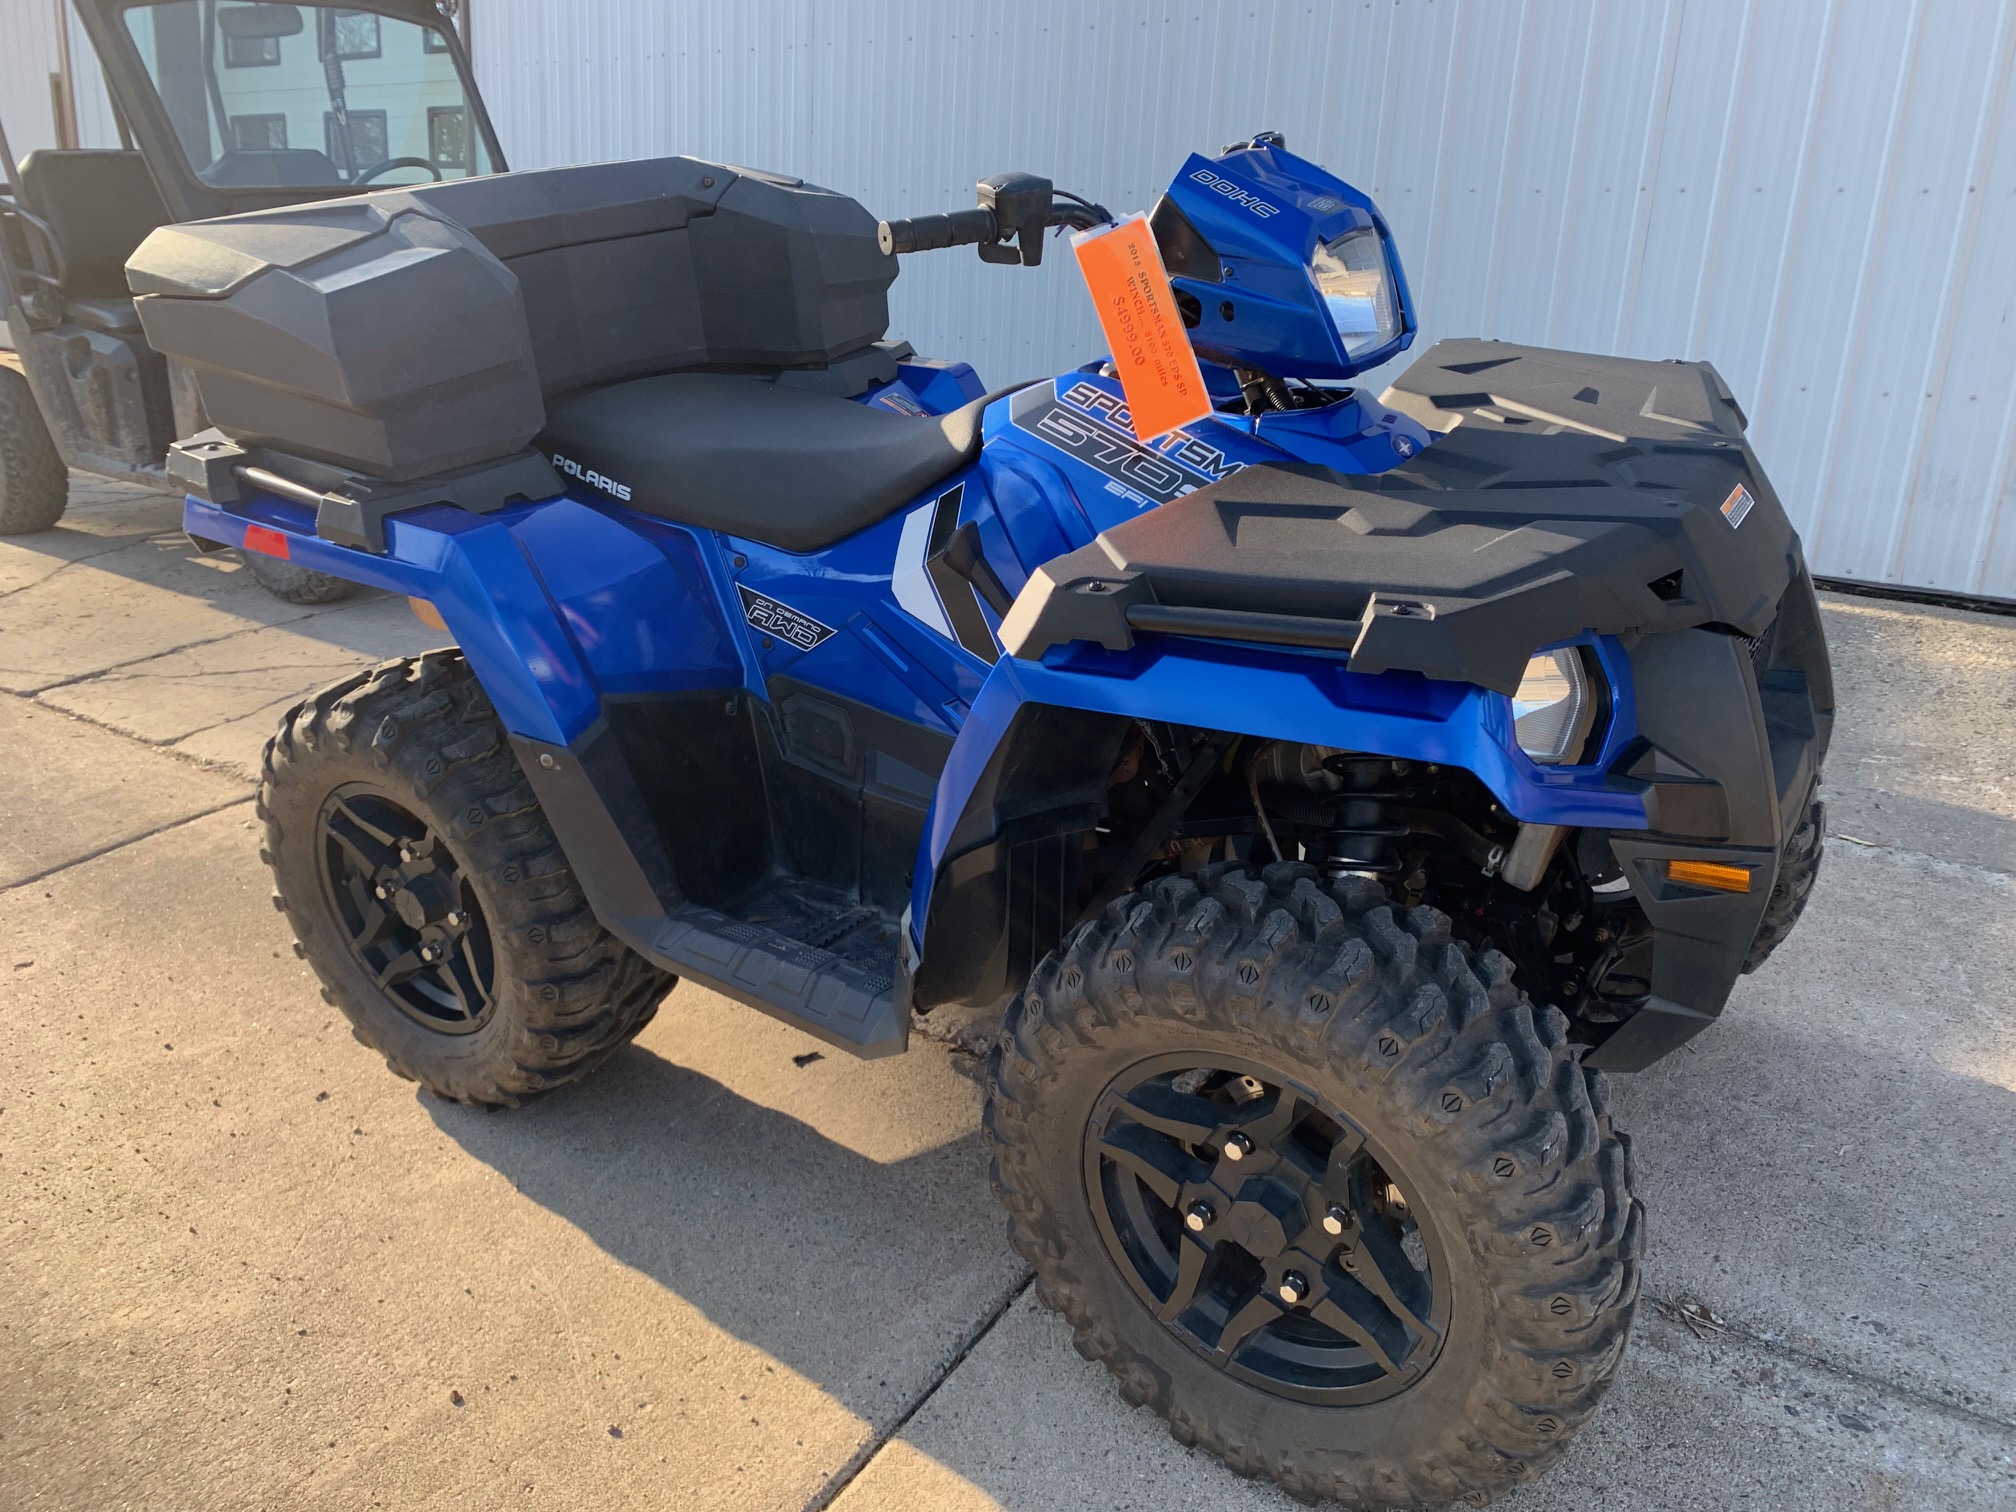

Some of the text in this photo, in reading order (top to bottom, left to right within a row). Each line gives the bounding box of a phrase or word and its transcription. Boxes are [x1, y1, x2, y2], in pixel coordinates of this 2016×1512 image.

[1190, 169, 1280, 218] DOHC
[1113, 295, 1146, 367] $4999.00
[1128, 243, 1142, 267] 2018
[1138, 271, 1168, 339] SPORTSMAN
[1162, 340, 1174, 358] 570
[1169, 358, 1183, 381] EPS
[1154, 358, 1169, 387] miles
[1061, 381, 1249, 480] SPOTSM
[552, 453, 631, 501] POLARIS
[1103, 481, 1148, 509] EFI
[747, 604, 818, 647] AWD
